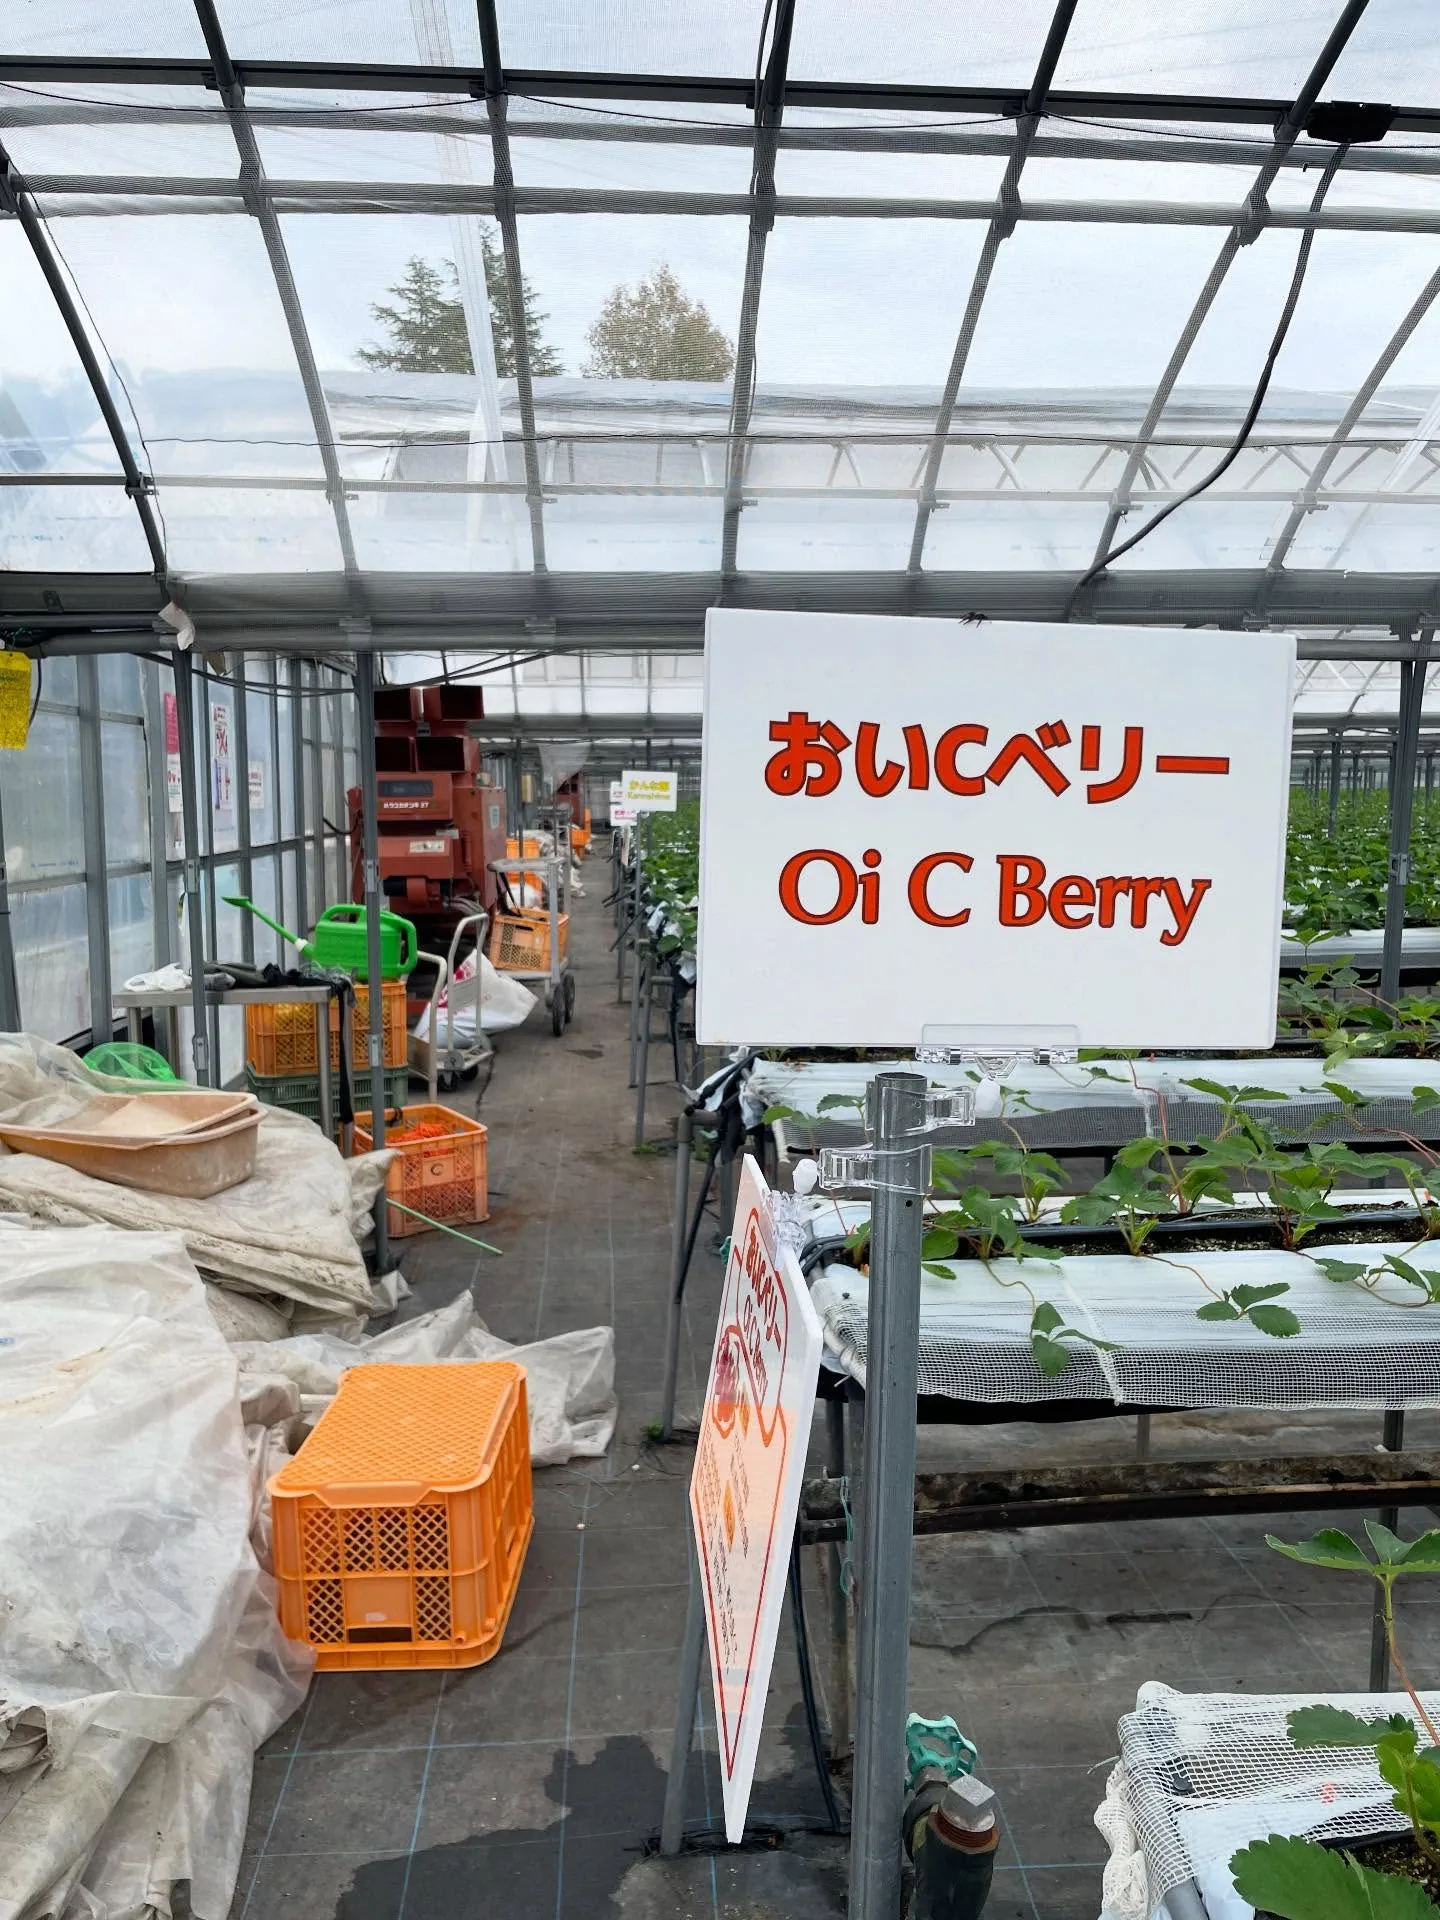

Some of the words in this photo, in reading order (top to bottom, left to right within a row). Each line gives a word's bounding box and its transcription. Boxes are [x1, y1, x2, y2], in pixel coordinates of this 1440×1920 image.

[764, 711, 1231, 805] おいCベリー
[779, 848, 882, 926] Oi
[907, 852, 975, 928] C
[995, 854, 1212, 947] Berry
